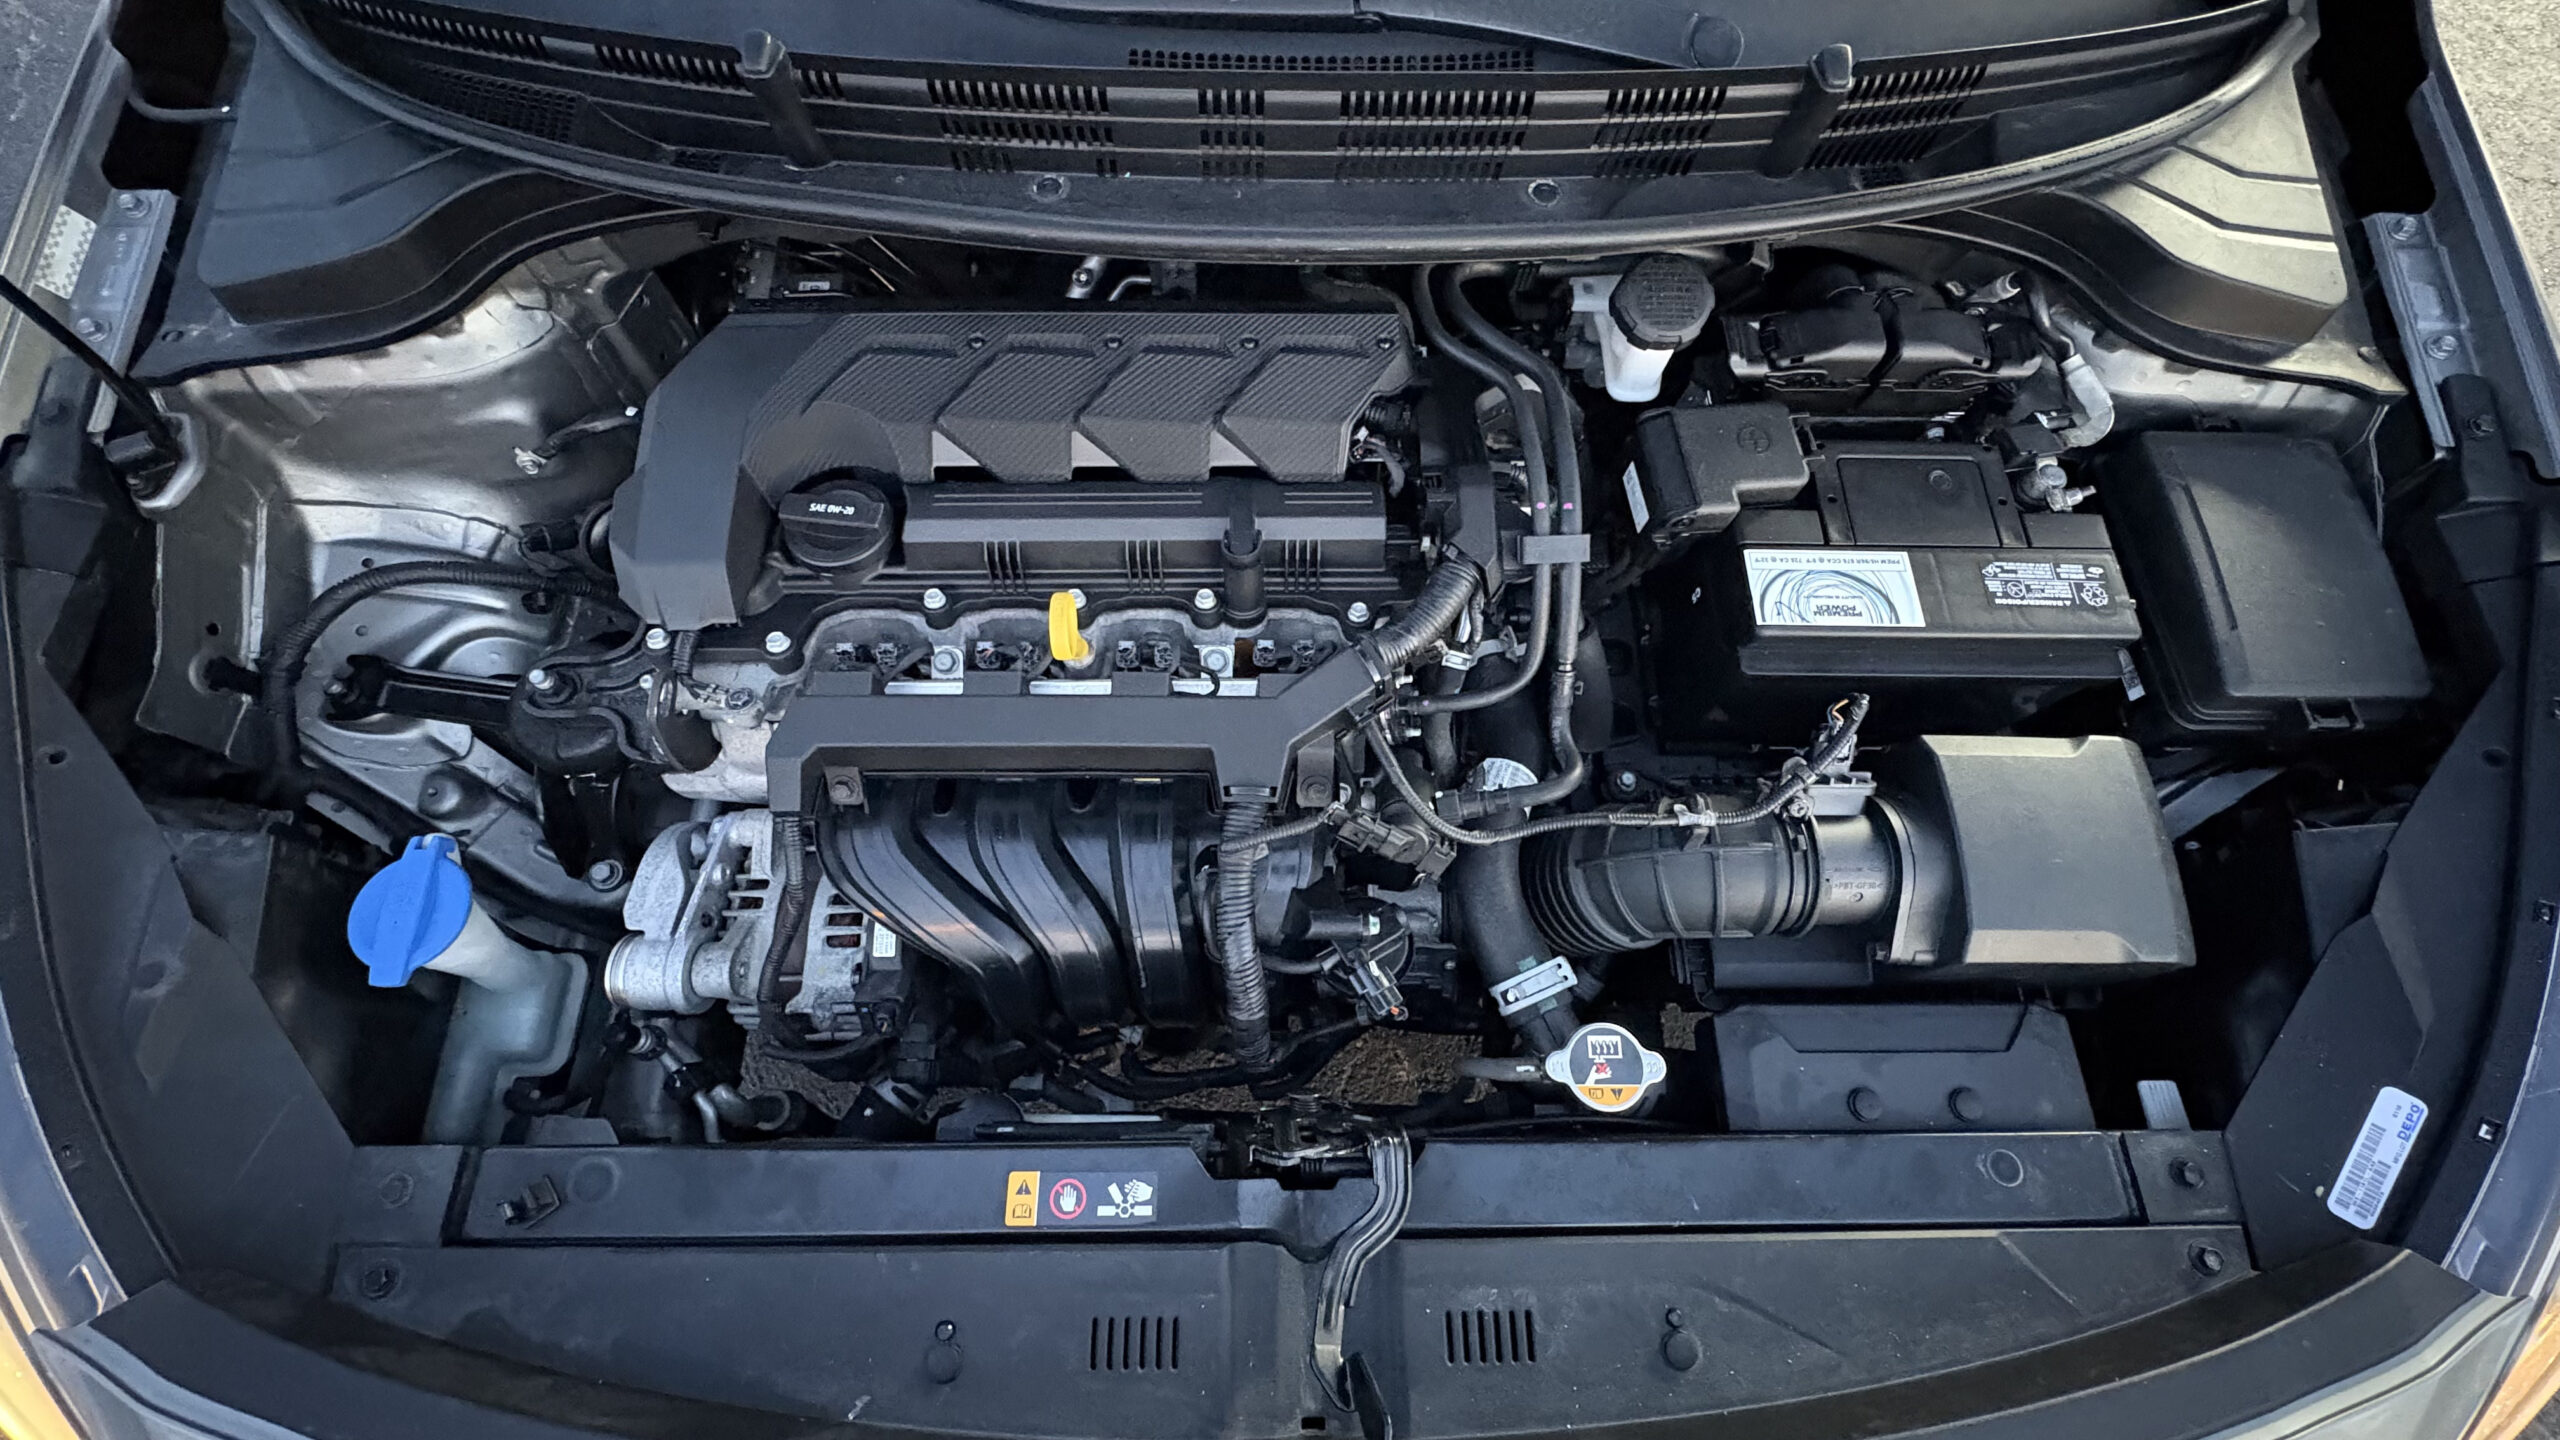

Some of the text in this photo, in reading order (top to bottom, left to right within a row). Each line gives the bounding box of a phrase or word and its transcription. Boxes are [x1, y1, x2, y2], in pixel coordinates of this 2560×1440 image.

[809, 503, 855, 515] SAE 0W-20
[2397, 1103, 2421, 1142] DEPO
